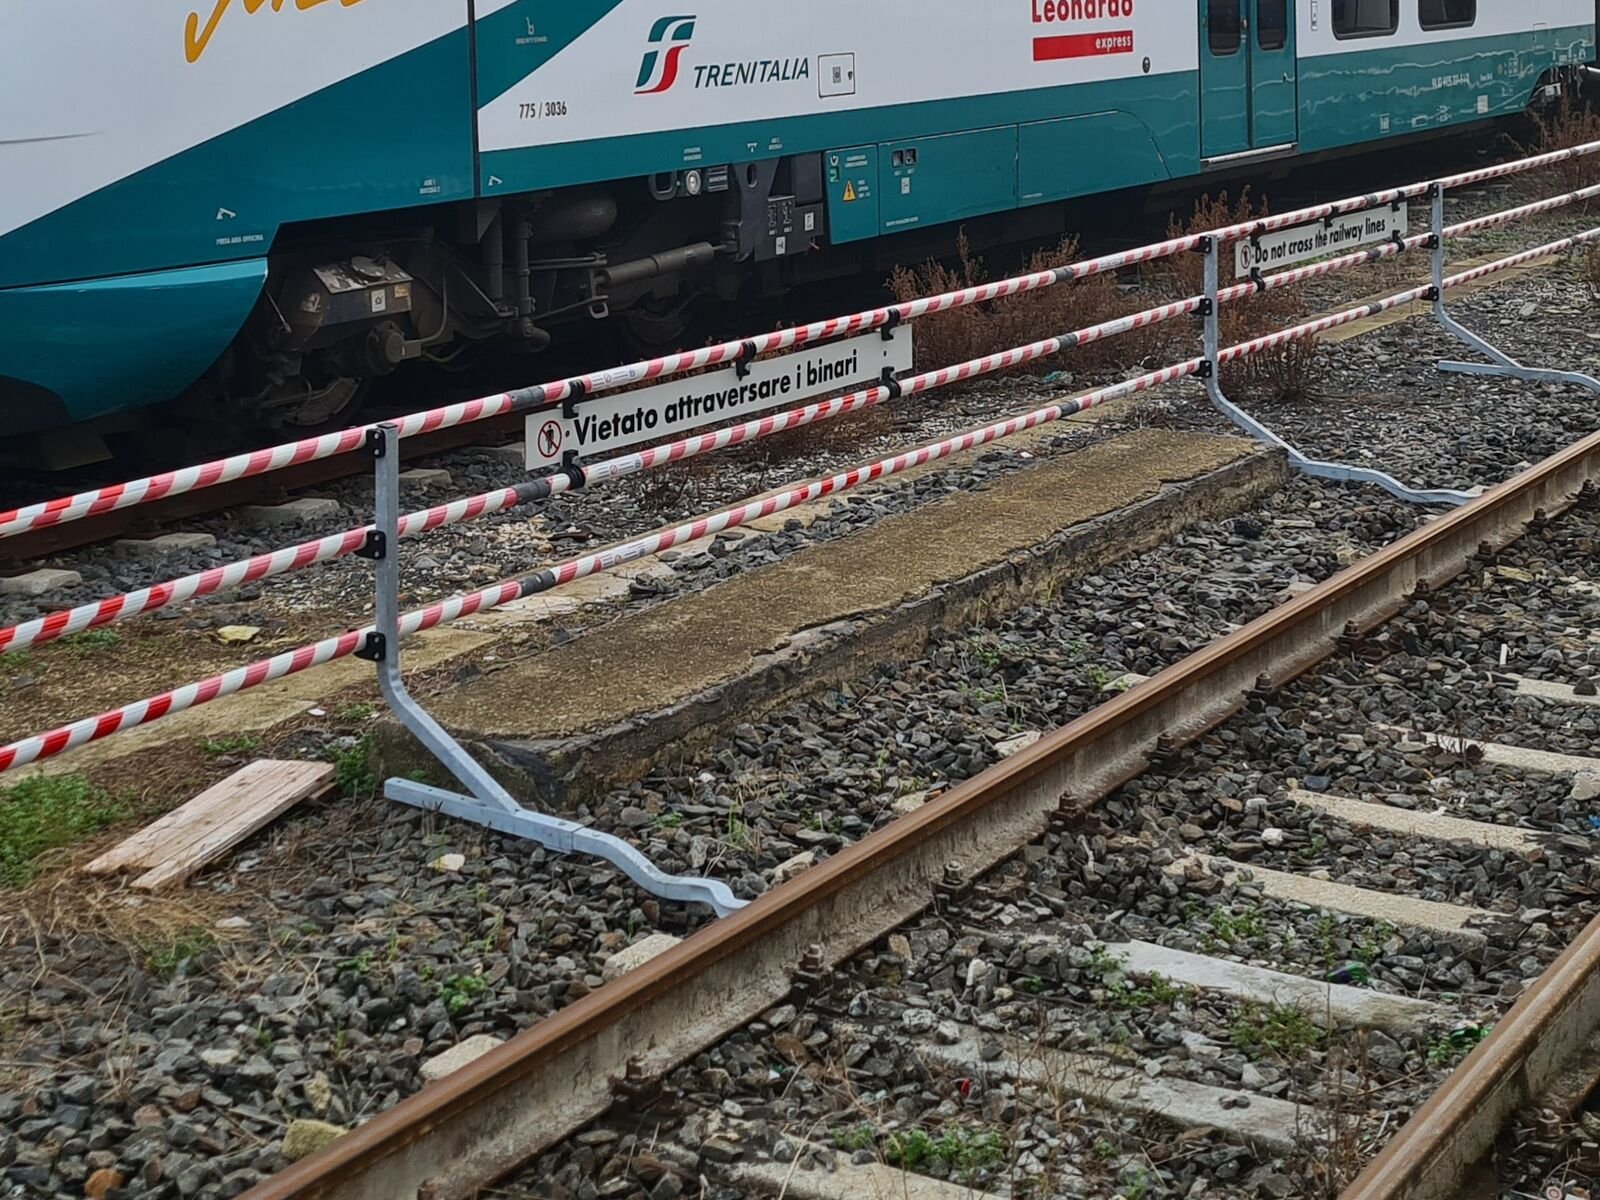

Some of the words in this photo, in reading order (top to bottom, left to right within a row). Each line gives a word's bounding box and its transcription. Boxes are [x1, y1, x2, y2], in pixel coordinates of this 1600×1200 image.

[1095, 35, 1132, 53] express
[694, 57, 809, 89] TRENITALIA
[520, 103, 536, 119] 775
[545, 100, 567, 117] 3036
[1255, 245, 1268, 264] Do
[1270, 244, 1286, 260] not
[1289, 239, 1313, 255] cross
[1315, 230, 1328, 248] the
[1329, 222, 1363, 245] railway
[1365, 217, 1386, 235] lines
[574, 407, 658, 446] Vietato
[665, 375, 791, 425] attraversare
[796, 364, 802, 389] i
[806, 349, 858, 387] binari
